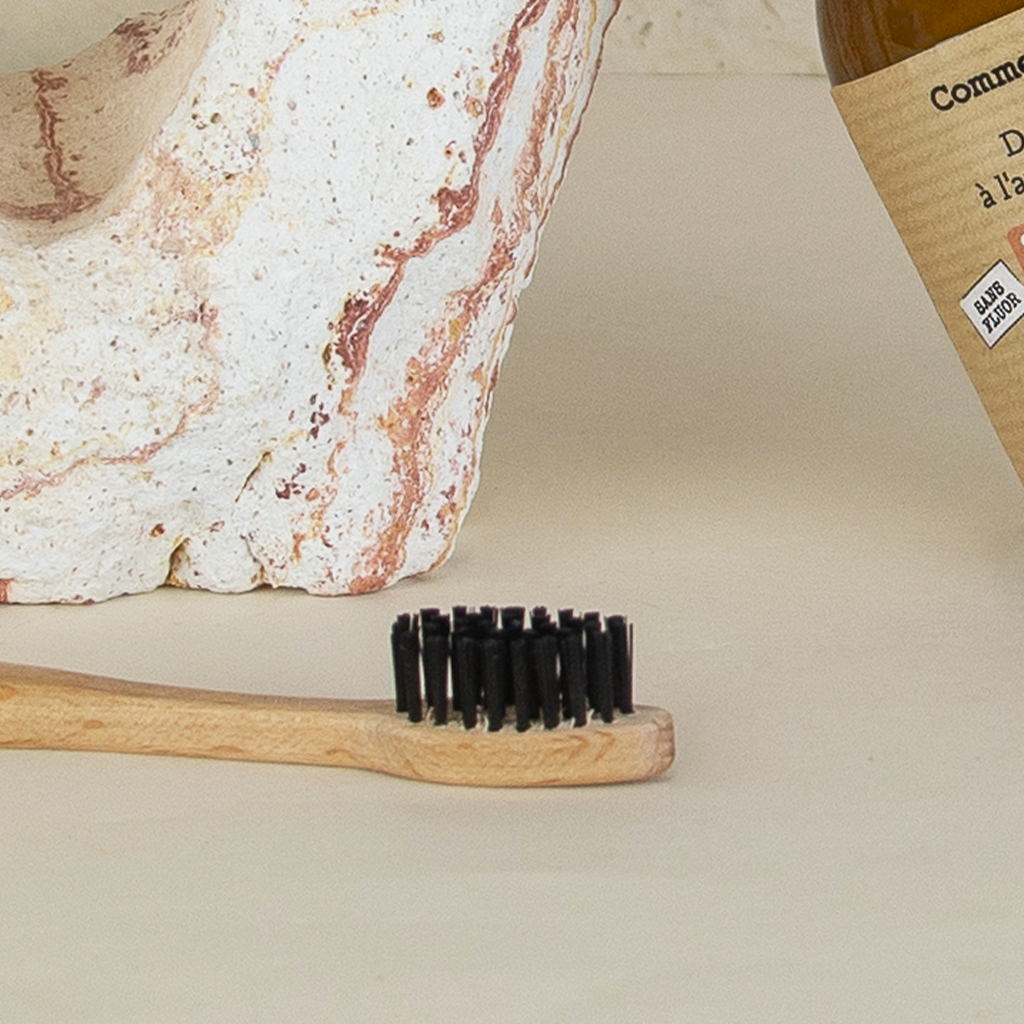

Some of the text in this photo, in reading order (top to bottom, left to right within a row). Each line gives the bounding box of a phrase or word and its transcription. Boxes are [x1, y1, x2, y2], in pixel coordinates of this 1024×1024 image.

[975, 182, 997, 209] à
[973, 280, 1005, 316] SANS
[982, 291, 1022, 334] FLUOR
